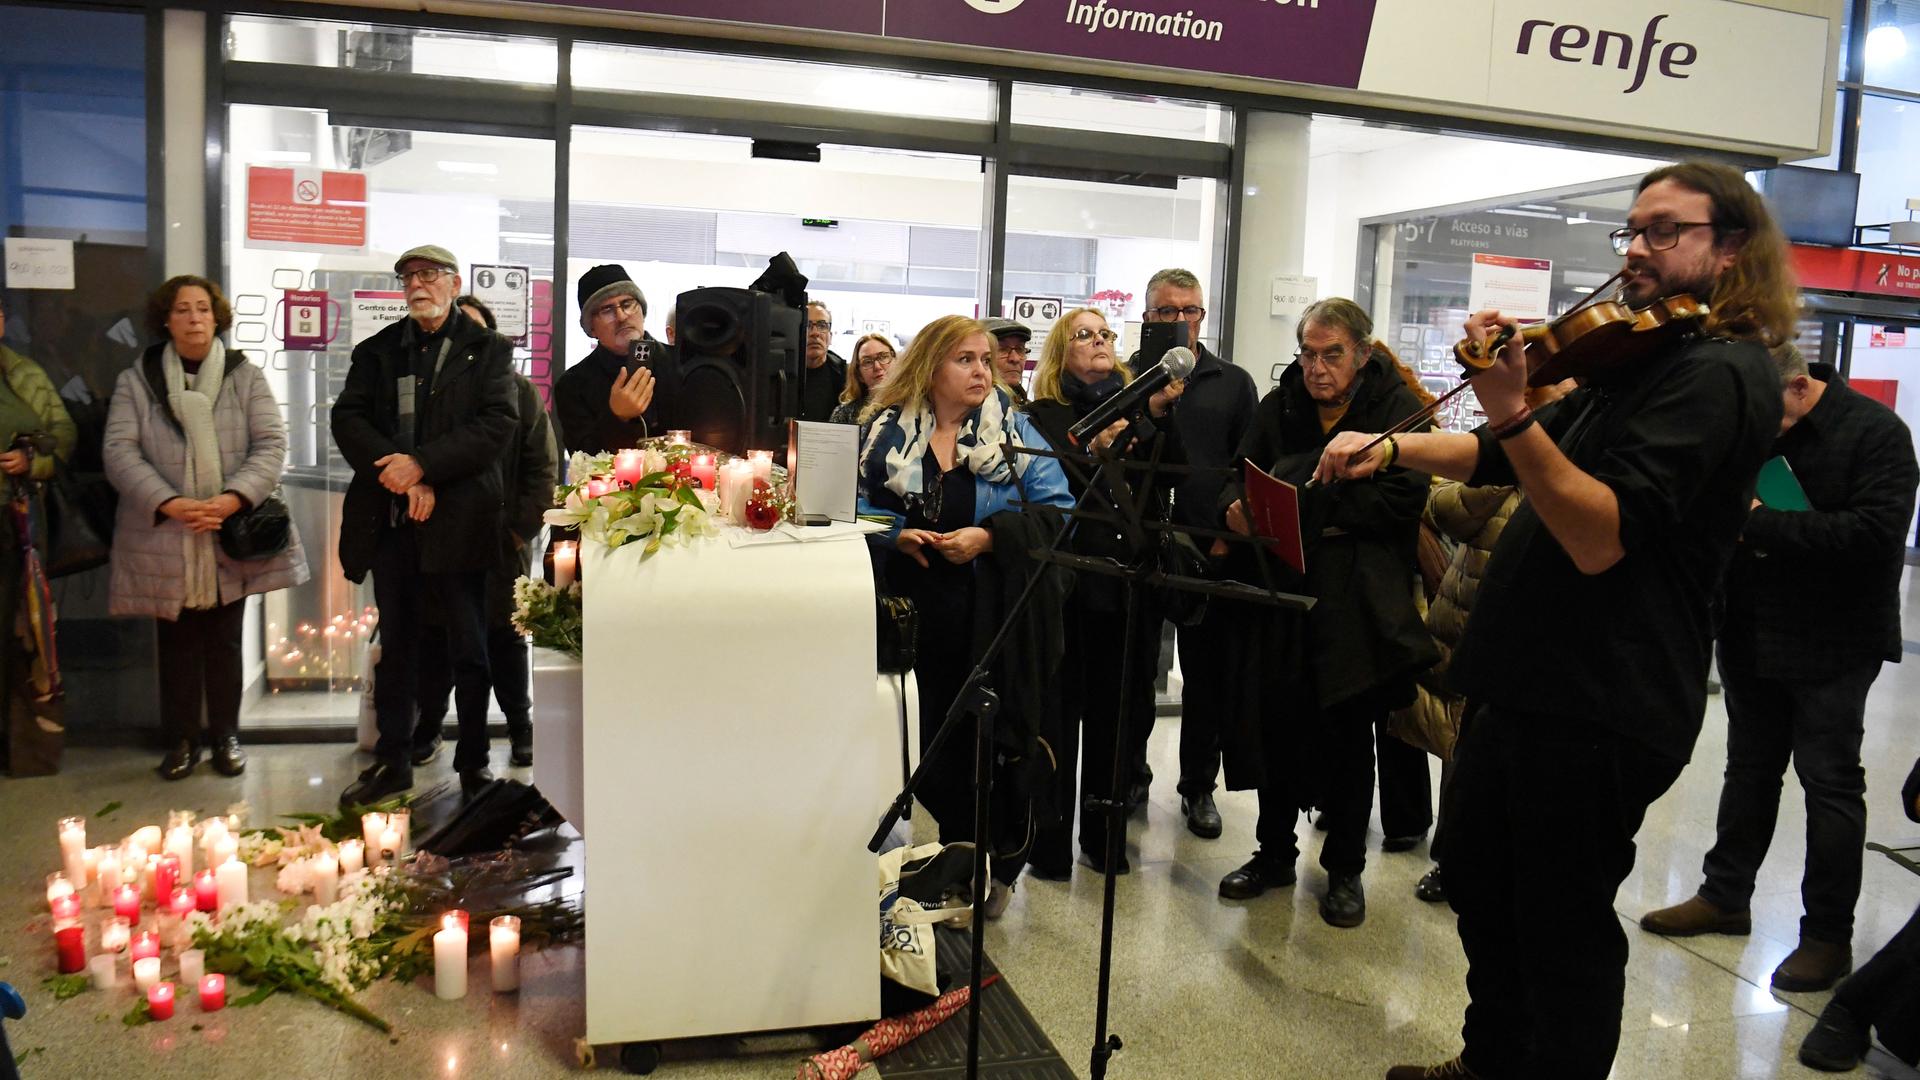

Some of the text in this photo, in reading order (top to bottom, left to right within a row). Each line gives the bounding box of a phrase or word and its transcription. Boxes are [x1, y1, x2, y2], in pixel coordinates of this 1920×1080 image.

[1066, 0, 1223, 41] Information
[1516, 14, 1698, 94] renfe
[1451, 219, 1529, 239] Acceso a vías
[1897, 264, 1910, 276] No
[358, 303, 385, 312] Centro
[387, 304, 398, 312] de
